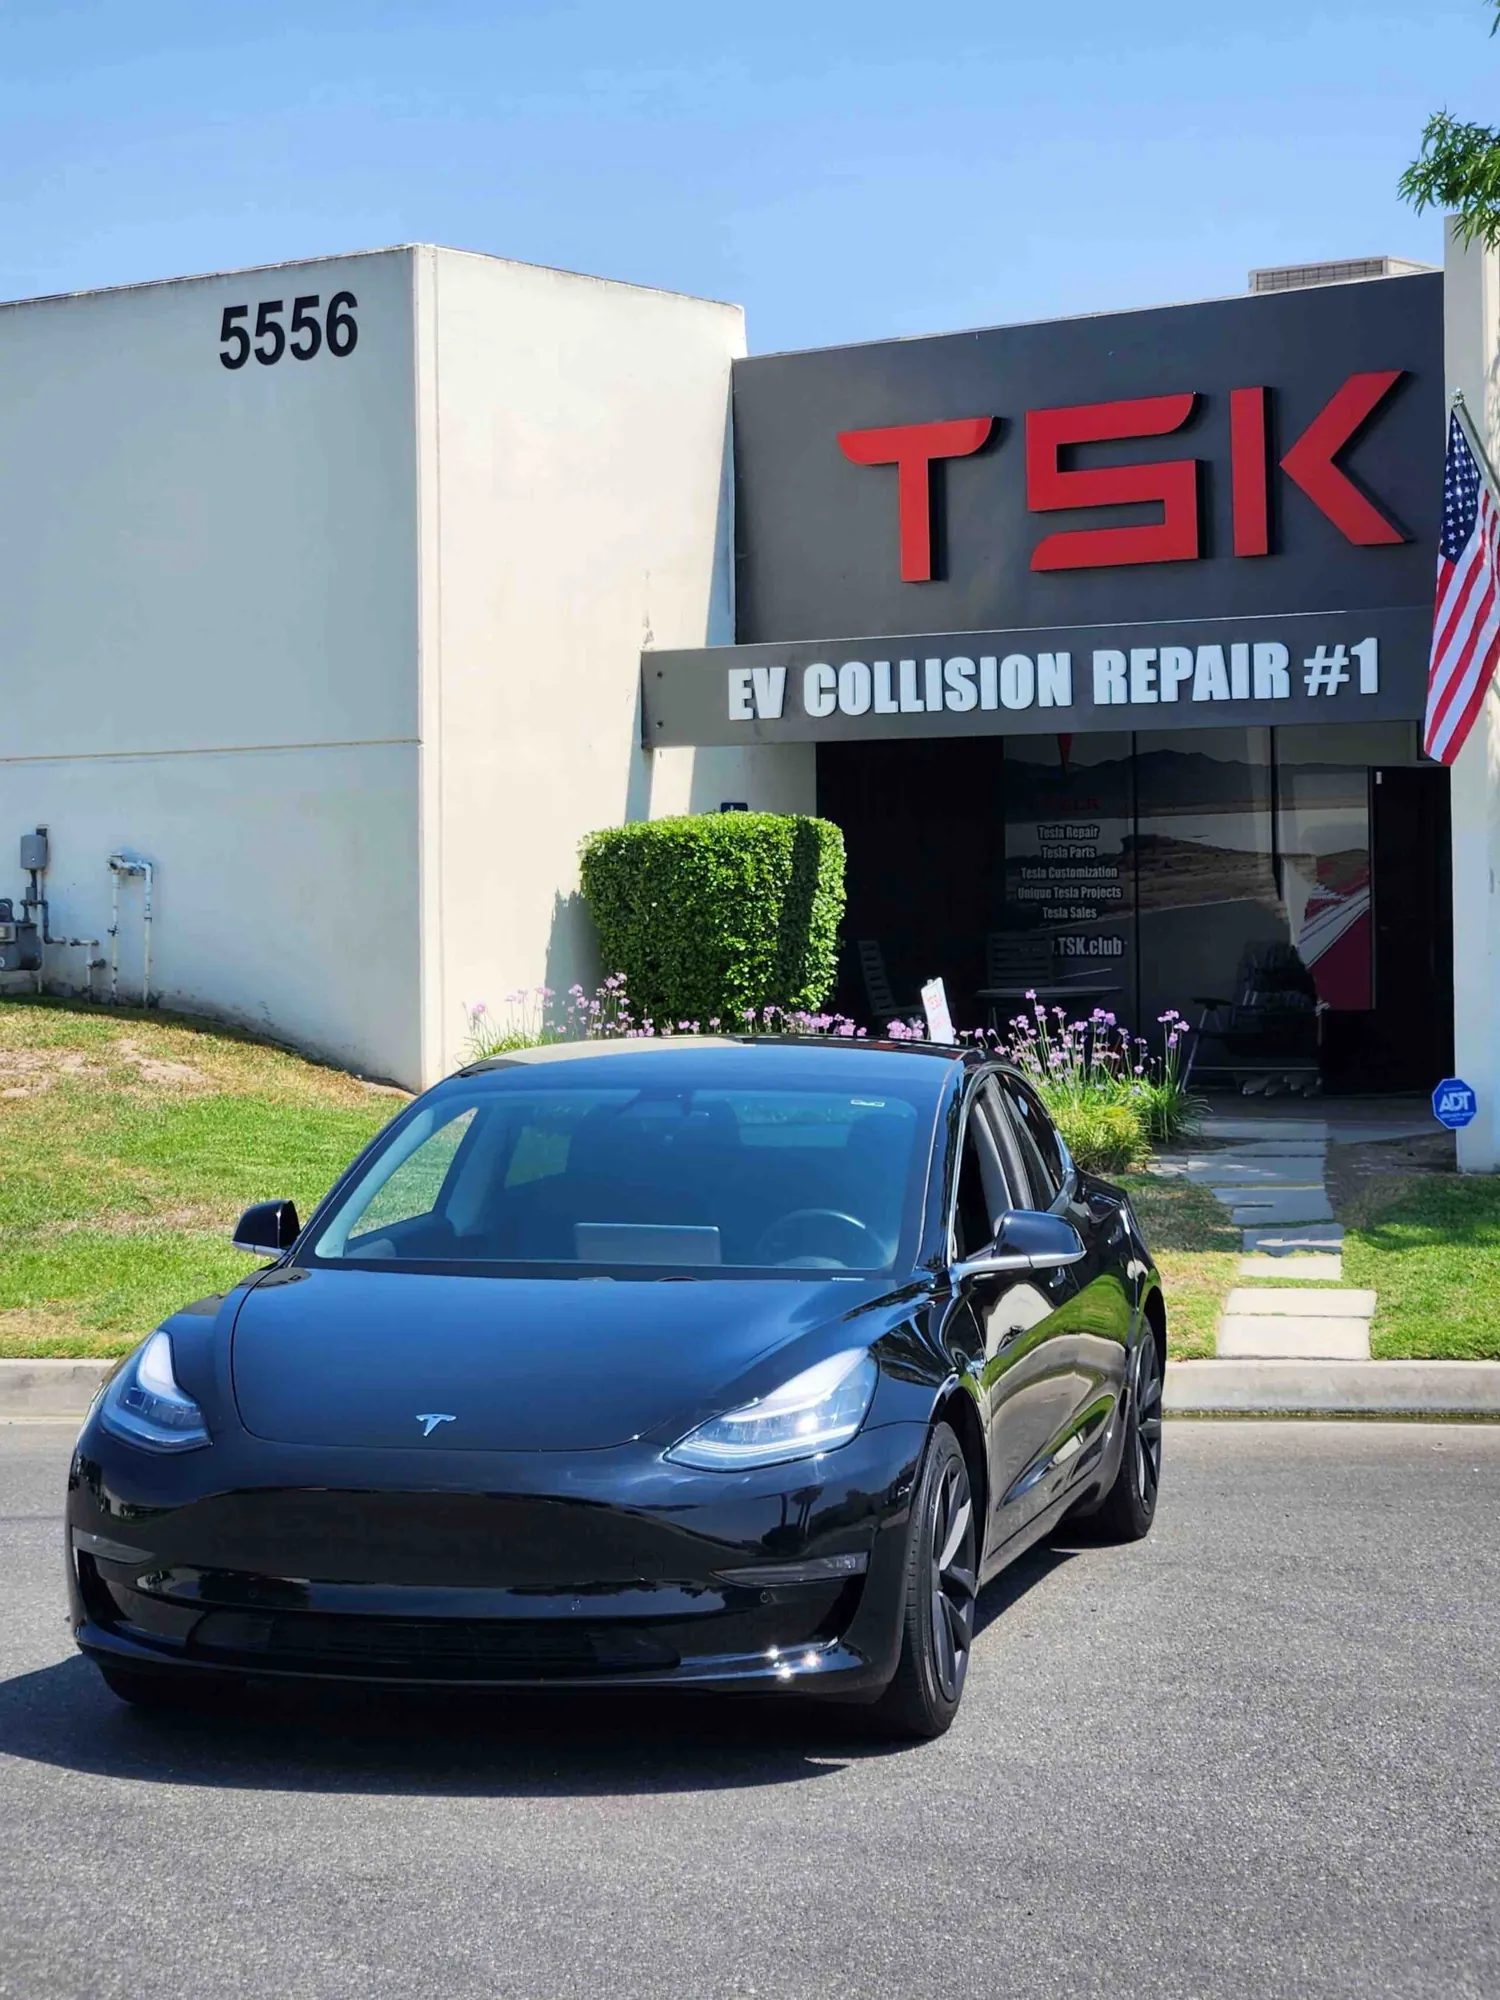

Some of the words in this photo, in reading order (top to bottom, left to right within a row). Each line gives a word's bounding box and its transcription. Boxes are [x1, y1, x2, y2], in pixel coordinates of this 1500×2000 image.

[220, 291, 358, 370] 5556
[837, 370, 1406, 583] TSK
[728, 666, 787, 720] EV
[803, 652, 1072, 718] COLLISION
[1093, 642, 1290, 705] REPAIR
[1303, 637, 1378, 697] #1
[1038, 826, 1064, 838] Tesla
[1066, 826, 1099, 839] Repair
[1042, 847, 1068, 858] Tesla
[1069, 847, 1096, 858] Parts
[1021, 867, 1047, 879] Tesla
[1048, 866, 1117, 879] Customization
[1018, 888, 1051, 900] Unique
[1053, 887, 1079, 899] Tesla
[1080, 887, 1122, 899] Projects
[1043, 907, 1068, 919] Tesla
[1070, 906, 1097, 919] Sales
[1052, 936, 1123, 956] .TSK.club
[1439, 1091, 1472, 1112] ADT
